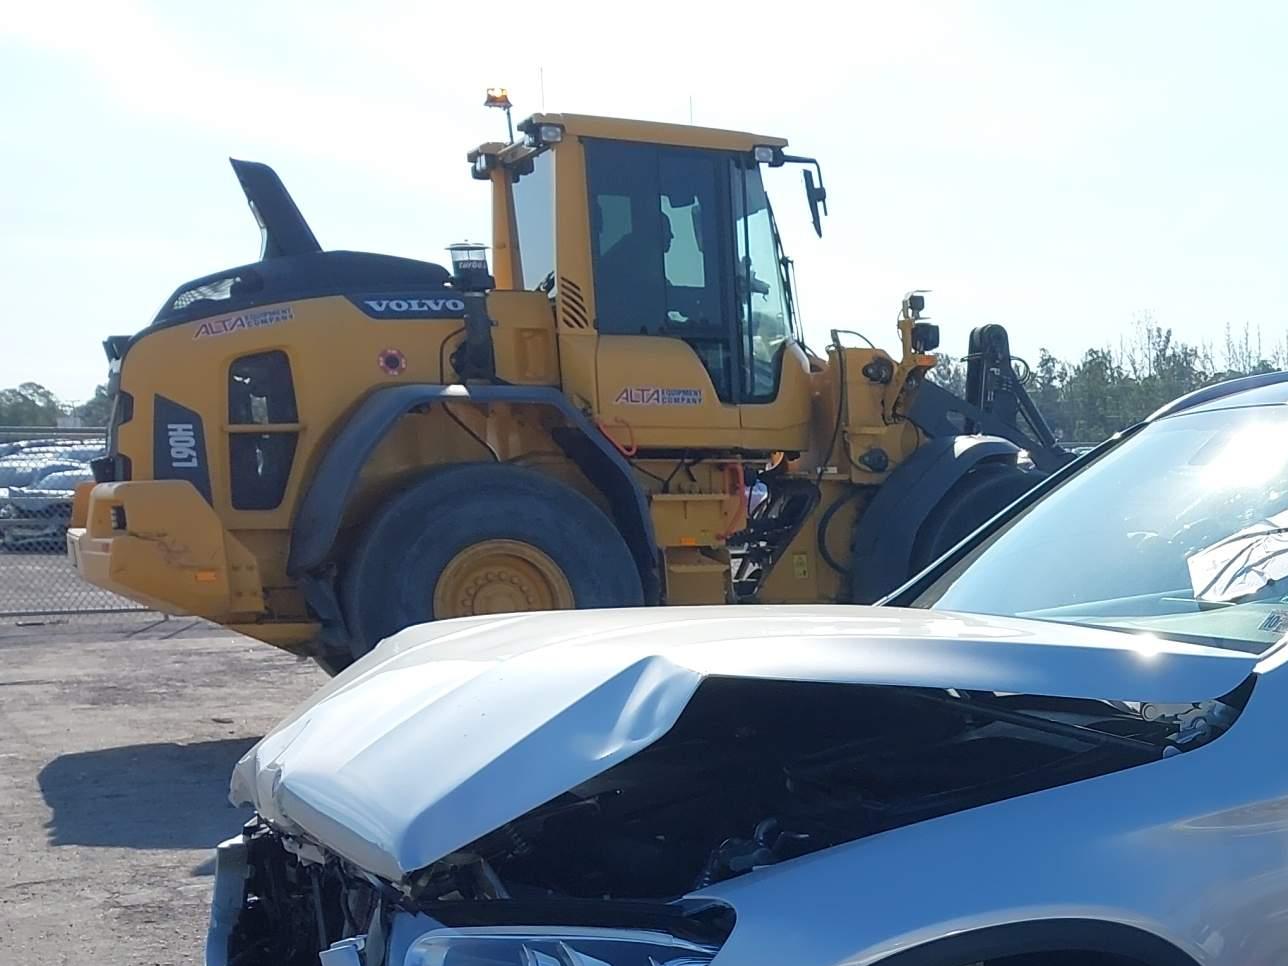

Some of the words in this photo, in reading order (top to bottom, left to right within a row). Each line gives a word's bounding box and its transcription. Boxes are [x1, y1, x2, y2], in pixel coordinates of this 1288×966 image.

[364, 299, 465, 312] VOLVO
[193, 316, 246, 339] ALTA
[615, 387, 660, 404] ALTA
[167, 423, 198, 467] L90H
